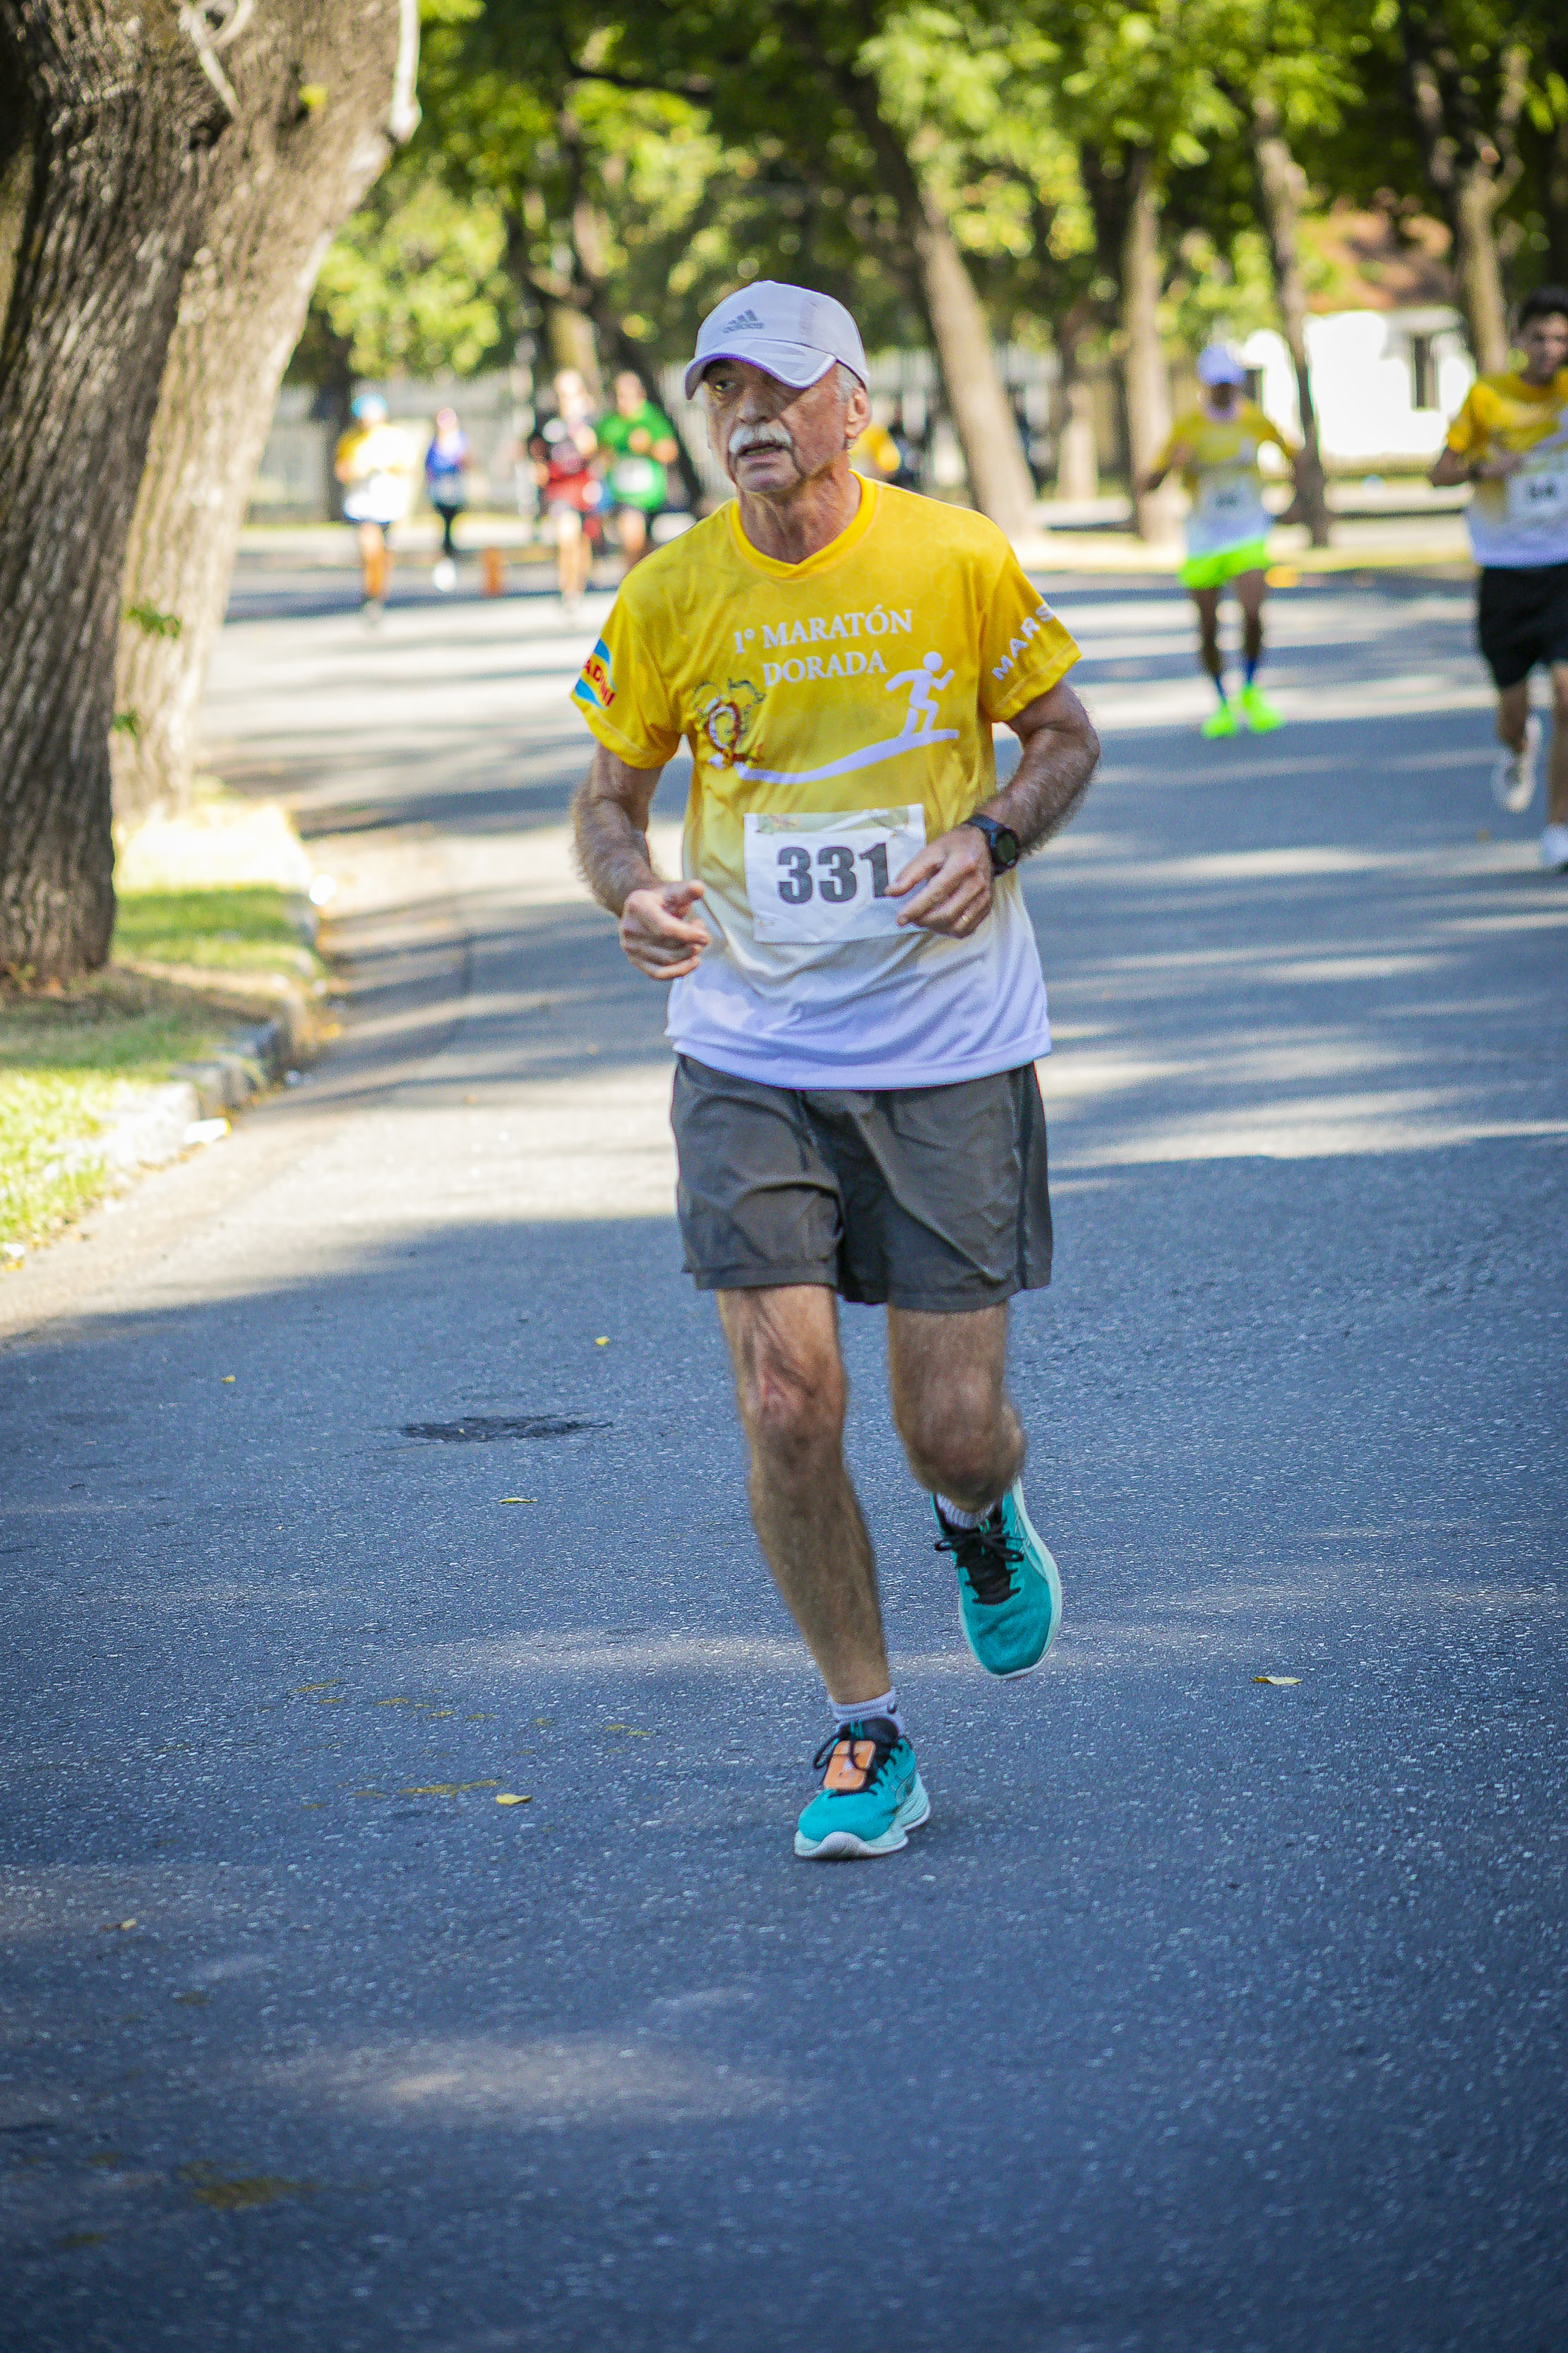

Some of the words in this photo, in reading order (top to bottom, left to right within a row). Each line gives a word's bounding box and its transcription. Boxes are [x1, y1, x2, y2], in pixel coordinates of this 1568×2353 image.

[762, 604, 913, 649] MARATÓN
[991, 602, 1054, 681] MARS
[762, 650, 887, 687] DORADA
[777, 841, 889, 904] 331
